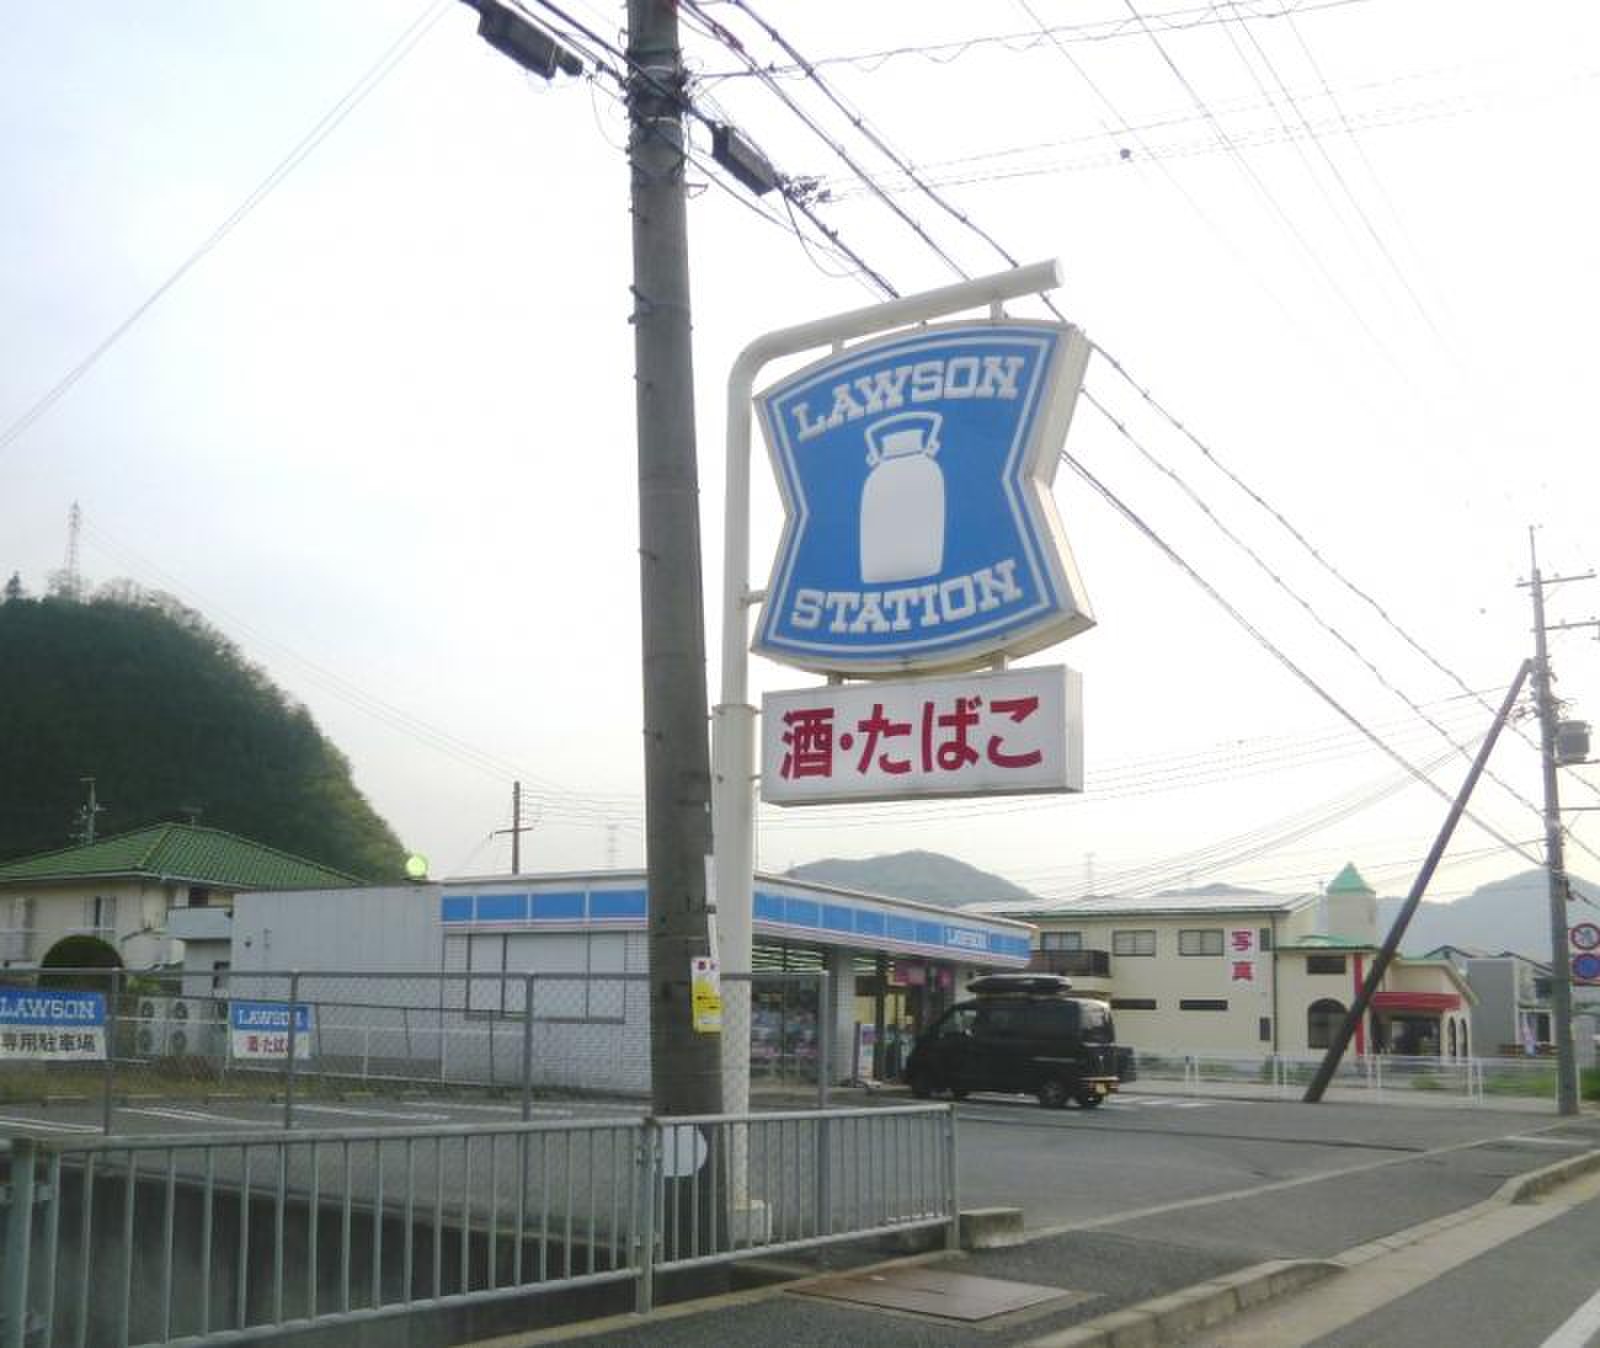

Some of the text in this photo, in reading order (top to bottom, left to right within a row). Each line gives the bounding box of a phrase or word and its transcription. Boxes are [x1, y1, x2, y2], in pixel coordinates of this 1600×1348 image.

[792, 356, 1024, 440] LAWSON
[791, 560, 1022, 634] STATION
[780, 695, 1043, 780] 酒・たばこ
[1231, 930, 1253, 982] 写真
[0, 998, 96, 1019] LAWSON
